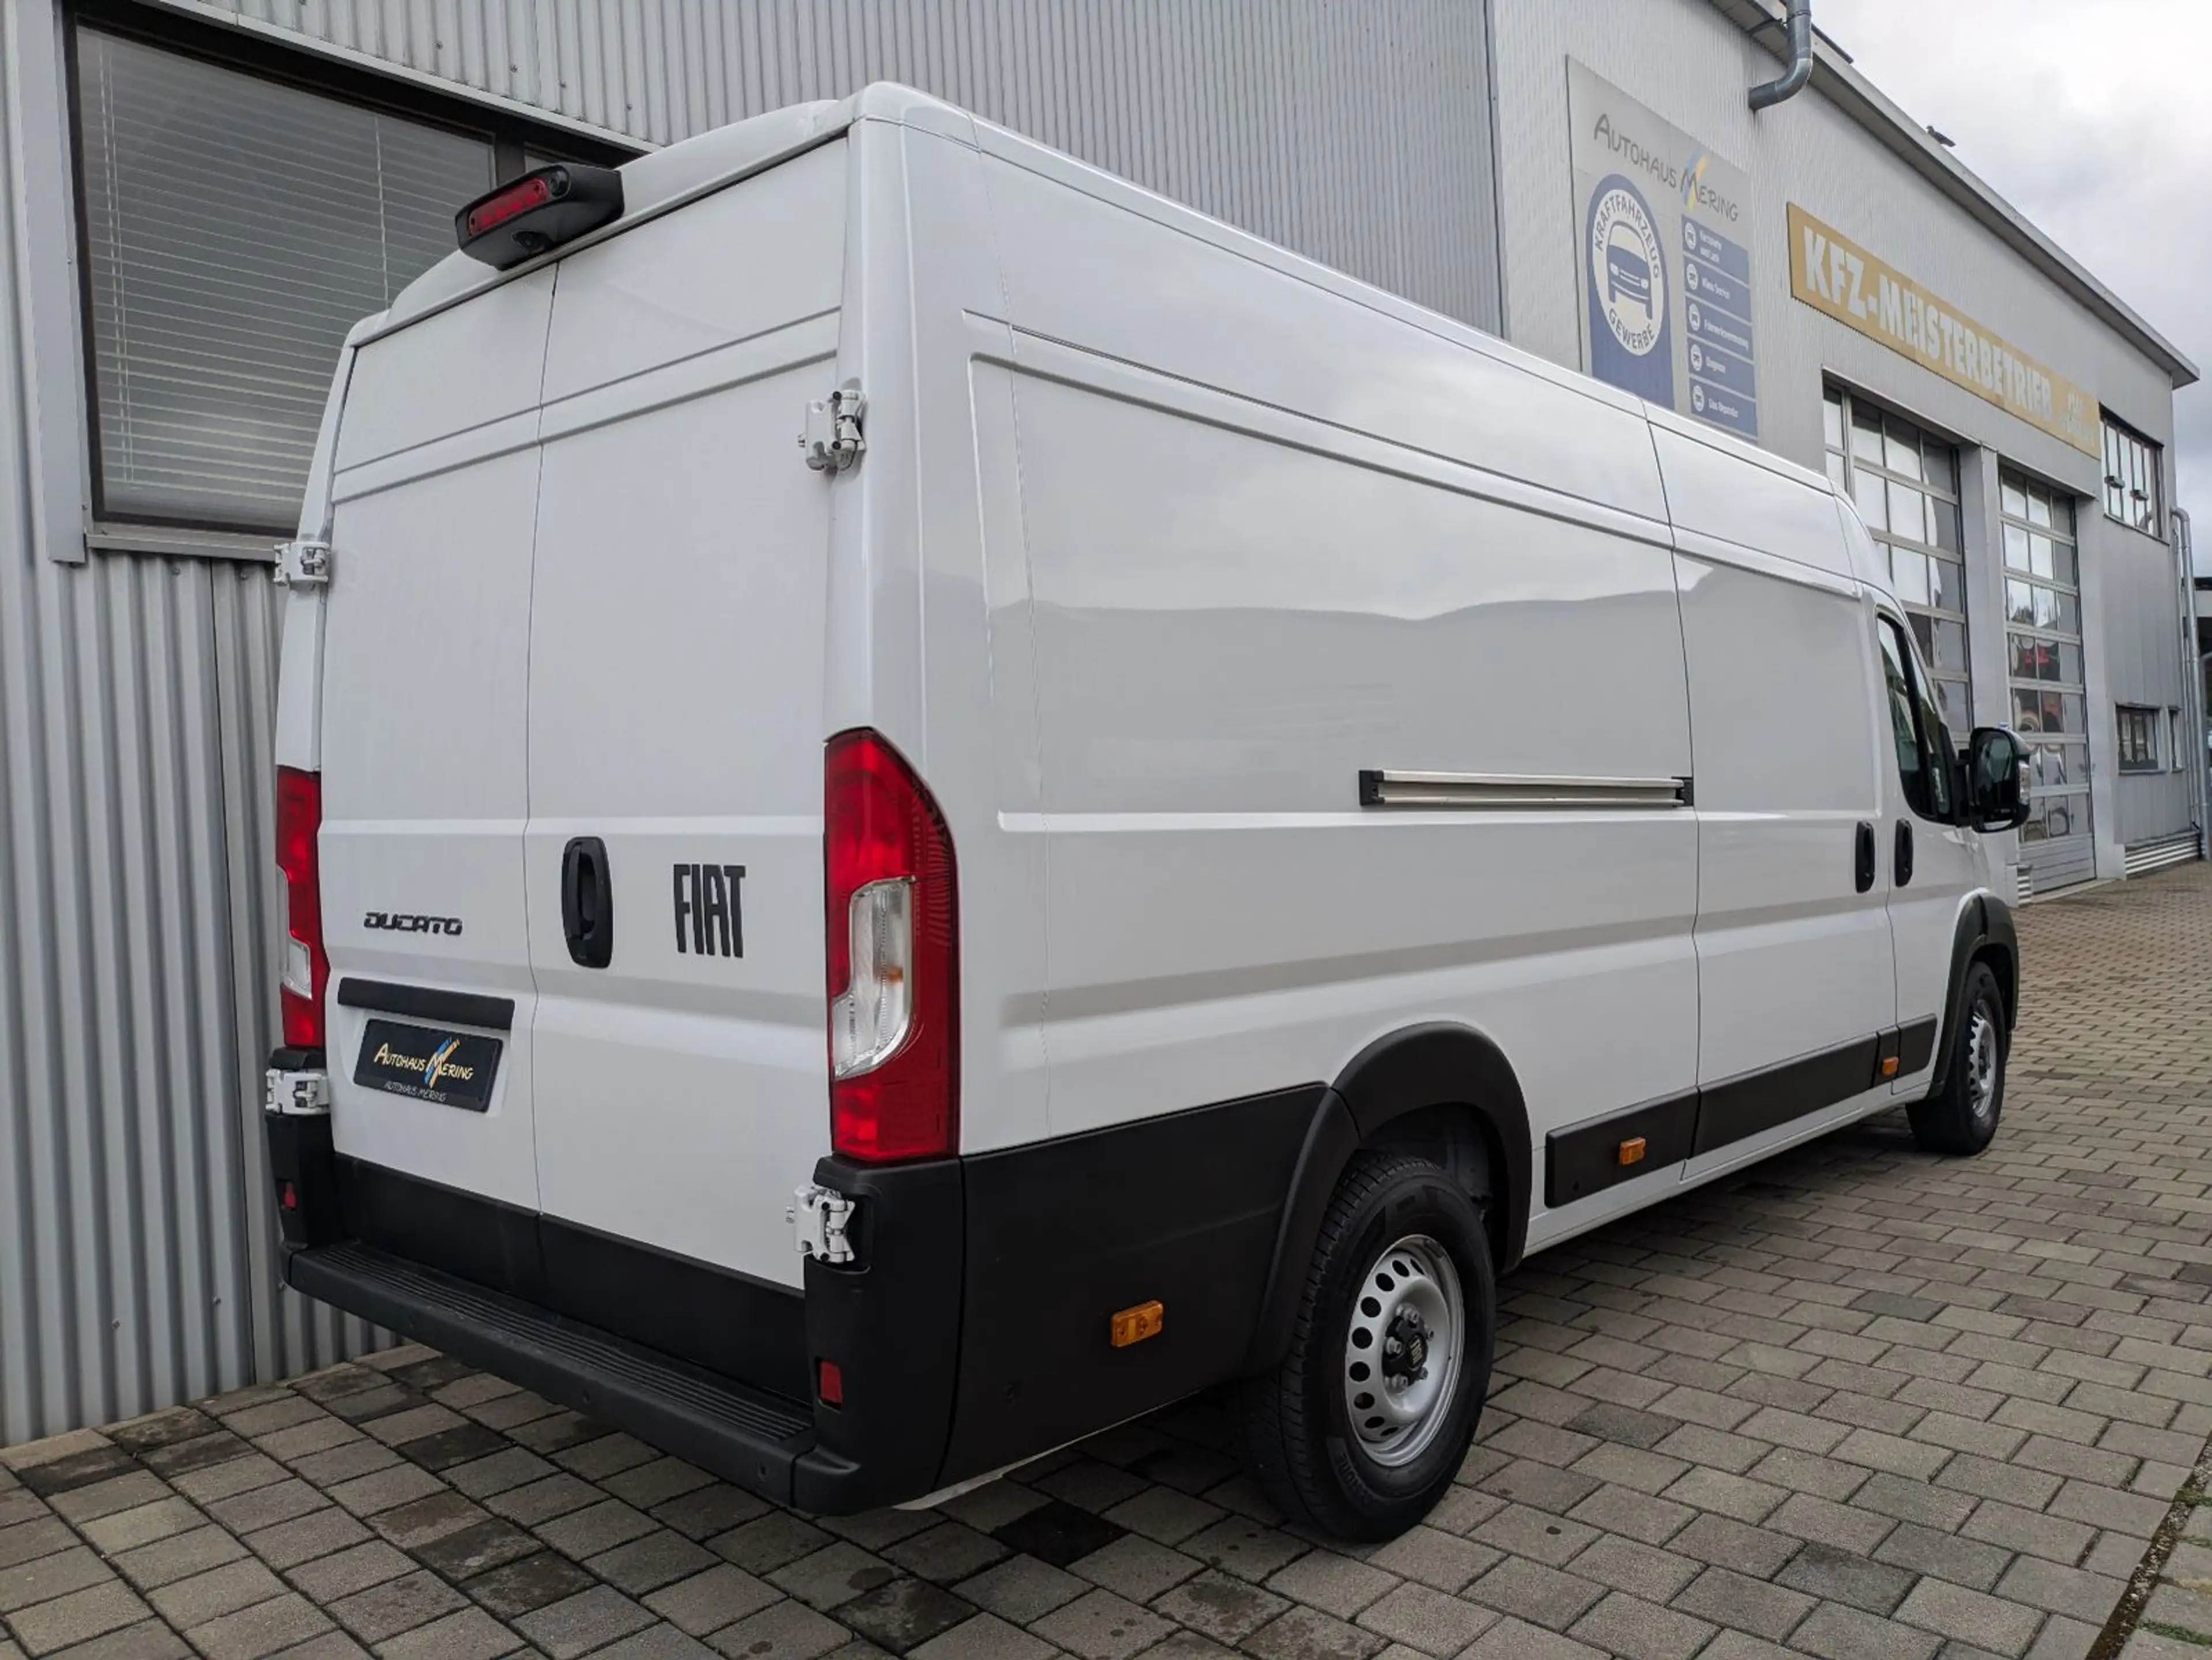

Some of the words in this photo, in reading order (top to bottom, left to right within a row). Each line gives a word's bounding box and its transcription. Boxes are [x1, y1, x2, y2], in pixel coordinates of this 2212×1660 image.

[1595, 194, 1660, 278] KRAFTFAHRZEUG
[1608, 308, 1655, 349] GEWERBE
[364, 912, 462, 935] DUCATO
[673, 863, 746, 959] FIAT
